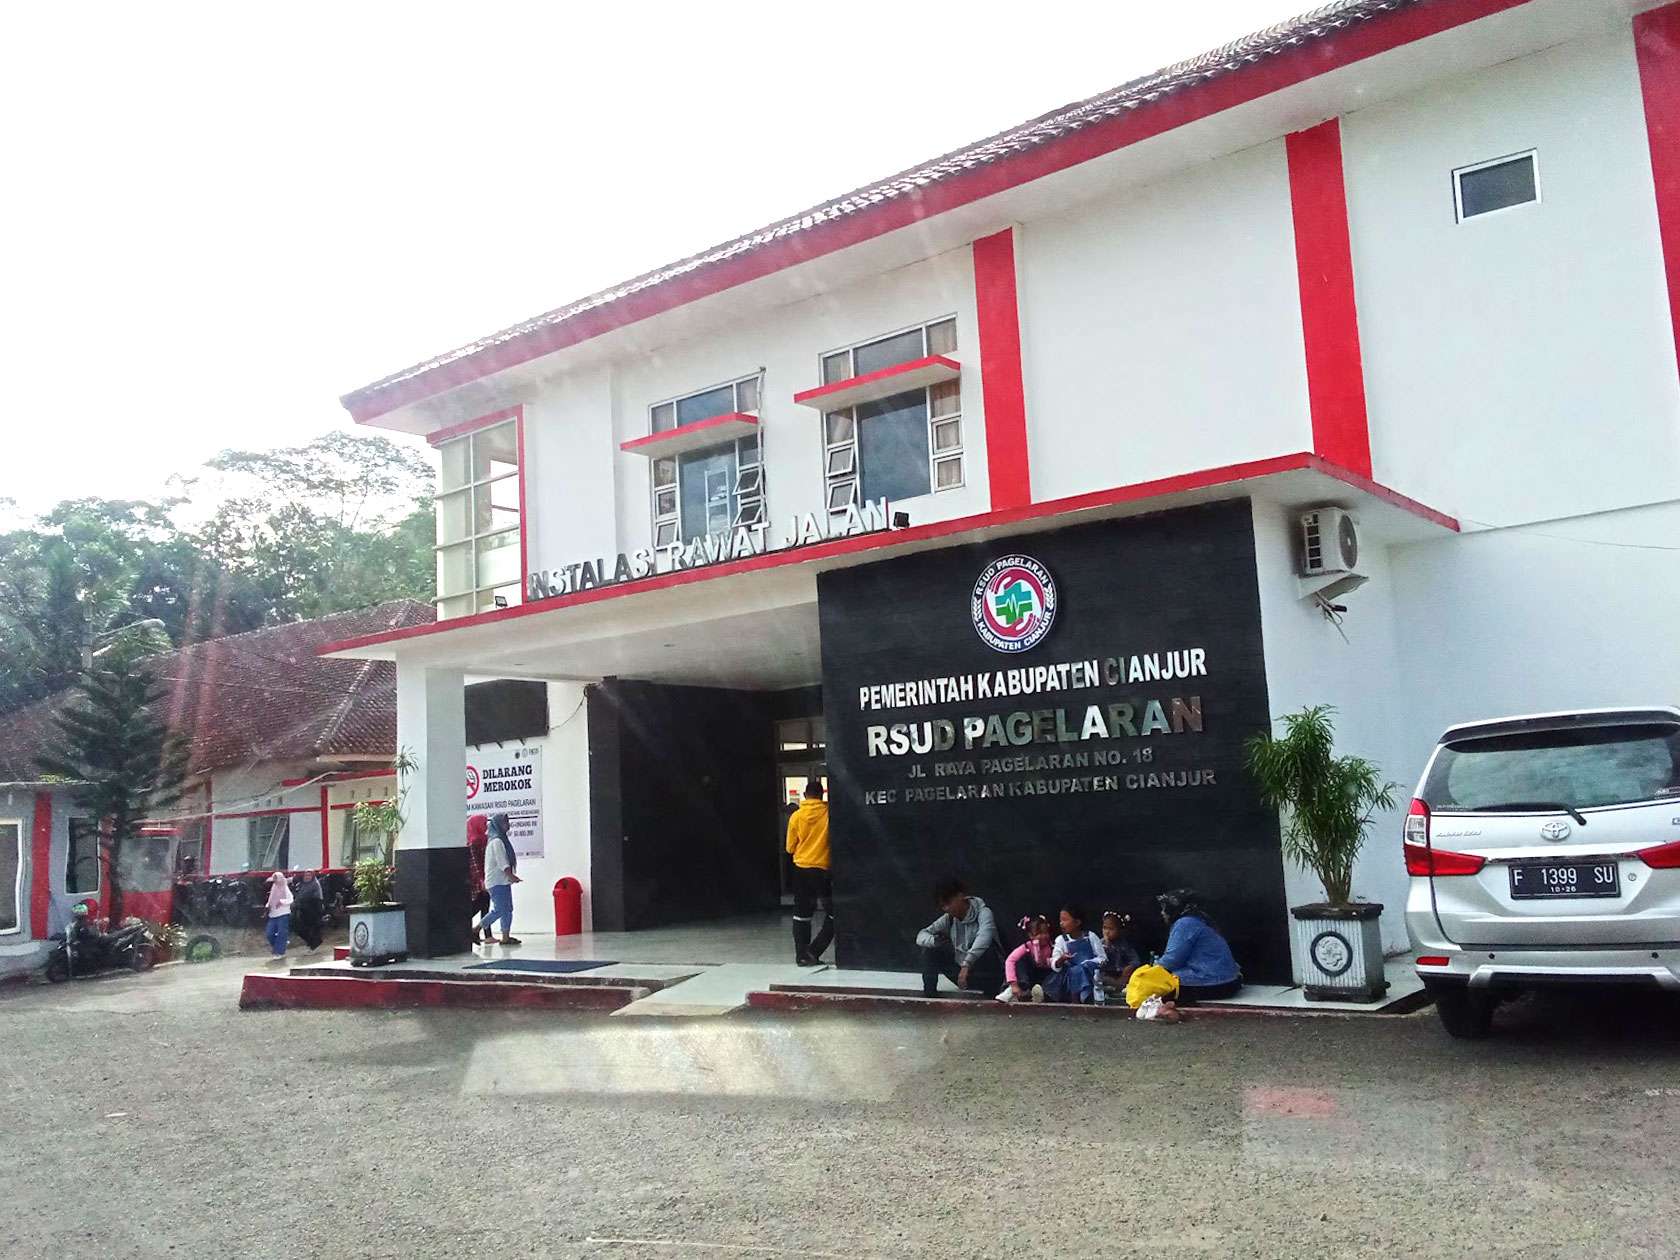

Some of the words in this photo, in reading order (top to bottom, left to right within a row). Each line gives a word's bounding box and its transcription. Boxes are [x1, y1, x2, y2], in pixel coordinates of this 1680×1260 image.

[667, 521, 772, 571] RAWAT
[785, 496, 890, 548] JALAN
[975, 568, 995, 596] RSUD
[996, 557, 1049, 584] PAGELARAN
[977, 621, 1021, 650] KABUPATEN
[1023, 611, 1052, 646] CIANJUR
[859, 674, 974, 711] PEMERINTAH
[977, 659, 1100, 700] KABUPATEN
[1104, 647, 1208, 687] CIANJUR
[867, 718, 955, 757] RSUD
[963, 696, 1203, 751] PAGELARAN
[482, 764, 533, 780] DILARANG
[908, 764, 926, 779] JL
[935, 760, 976, 777] RAYA
[981, 751, 1089, 774] PAGELARAN
[1094, 750, 1127, 766] NO.
[1133, 745, 1153, 764] 18
[483, 778, 533, 793] MEROKOK
[865, 789, 897, 805] KEC
[905, 784, 1004, 802] PAGELARAN
[1009, 775, 1119, 797] KABUPATEN
[1125, 768, 1217, 790] CIANJUR
[1513, 869, 1523, 886] F
[1541, 867, 1577, 885] 1399
[1593, 866, 1613, 884] SU
